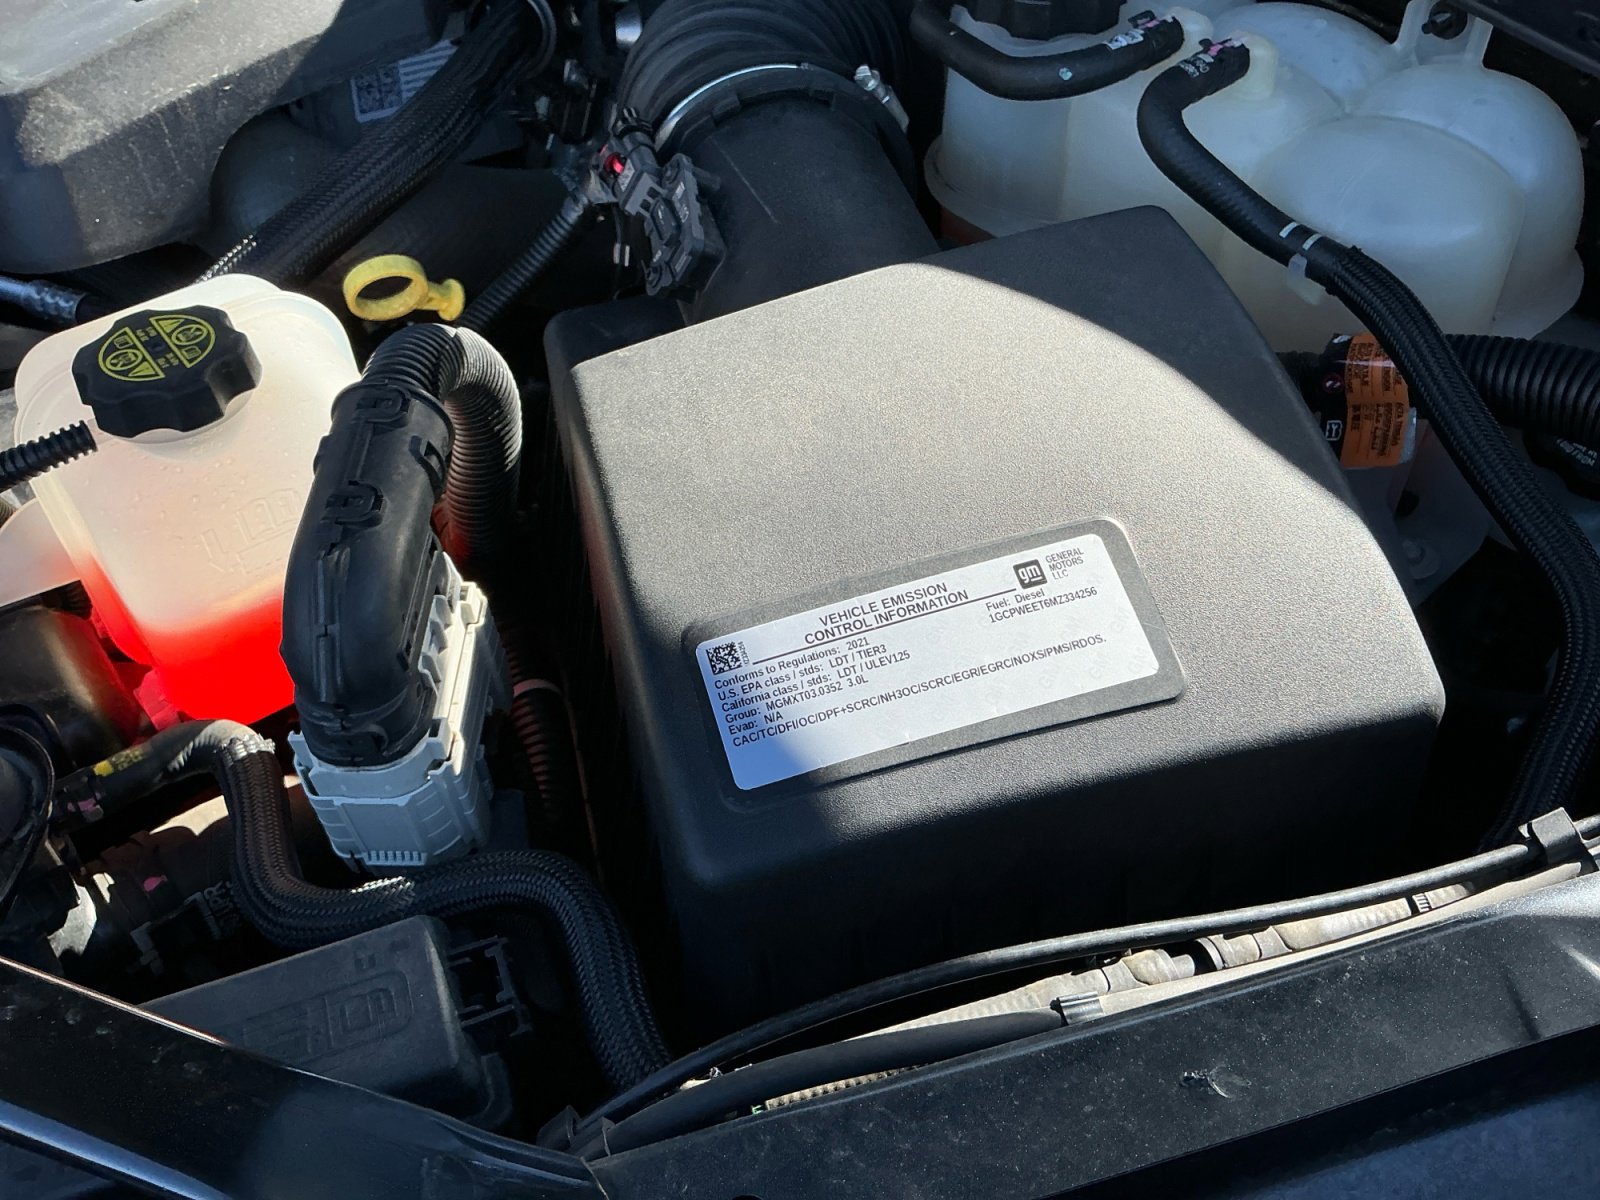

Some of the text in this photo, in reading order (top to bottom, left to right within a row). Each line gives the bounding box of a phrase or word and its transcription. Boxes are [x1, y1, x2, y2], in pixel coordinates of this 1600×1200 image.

[1045, 547, 1084, 564] GENERAL
[1049, 557, 1084, 572] MOTORS
[1052, 569, 1069, 580] LLC
[805, 590, 969, 644] CONTROL INFORMATION
[819, 582, 948, 626] VEHICLE EMISSION
[985, 588, 1045, 612] Fuel: Diesel
[989, 586, 1098, 623] 1GCPWEET6MZ334256
[715, 637, 870, 690] Conforms to Regulations: 2021
[718, 687, 740, 701] U.S.
[742, 681, 763, 695] EPA
[765, 672, 791, 687] class
[799, 663, 824, 678] stds:
[829, 654, 849, 669] LDT
[859, 644, 887, 660] TIER3
[721, 692, 772, 713] California
[773, 683, 799, 697] class
[808, 673, 832, 687] stds:
[837, 664, 857, 679] LDT
[866, 650, 911, 670] ULEV125
[725, 676, 869, 724] Group: MGMXT03.0352 3.0L
[728, 712, 784, 735] Evap: N/A
